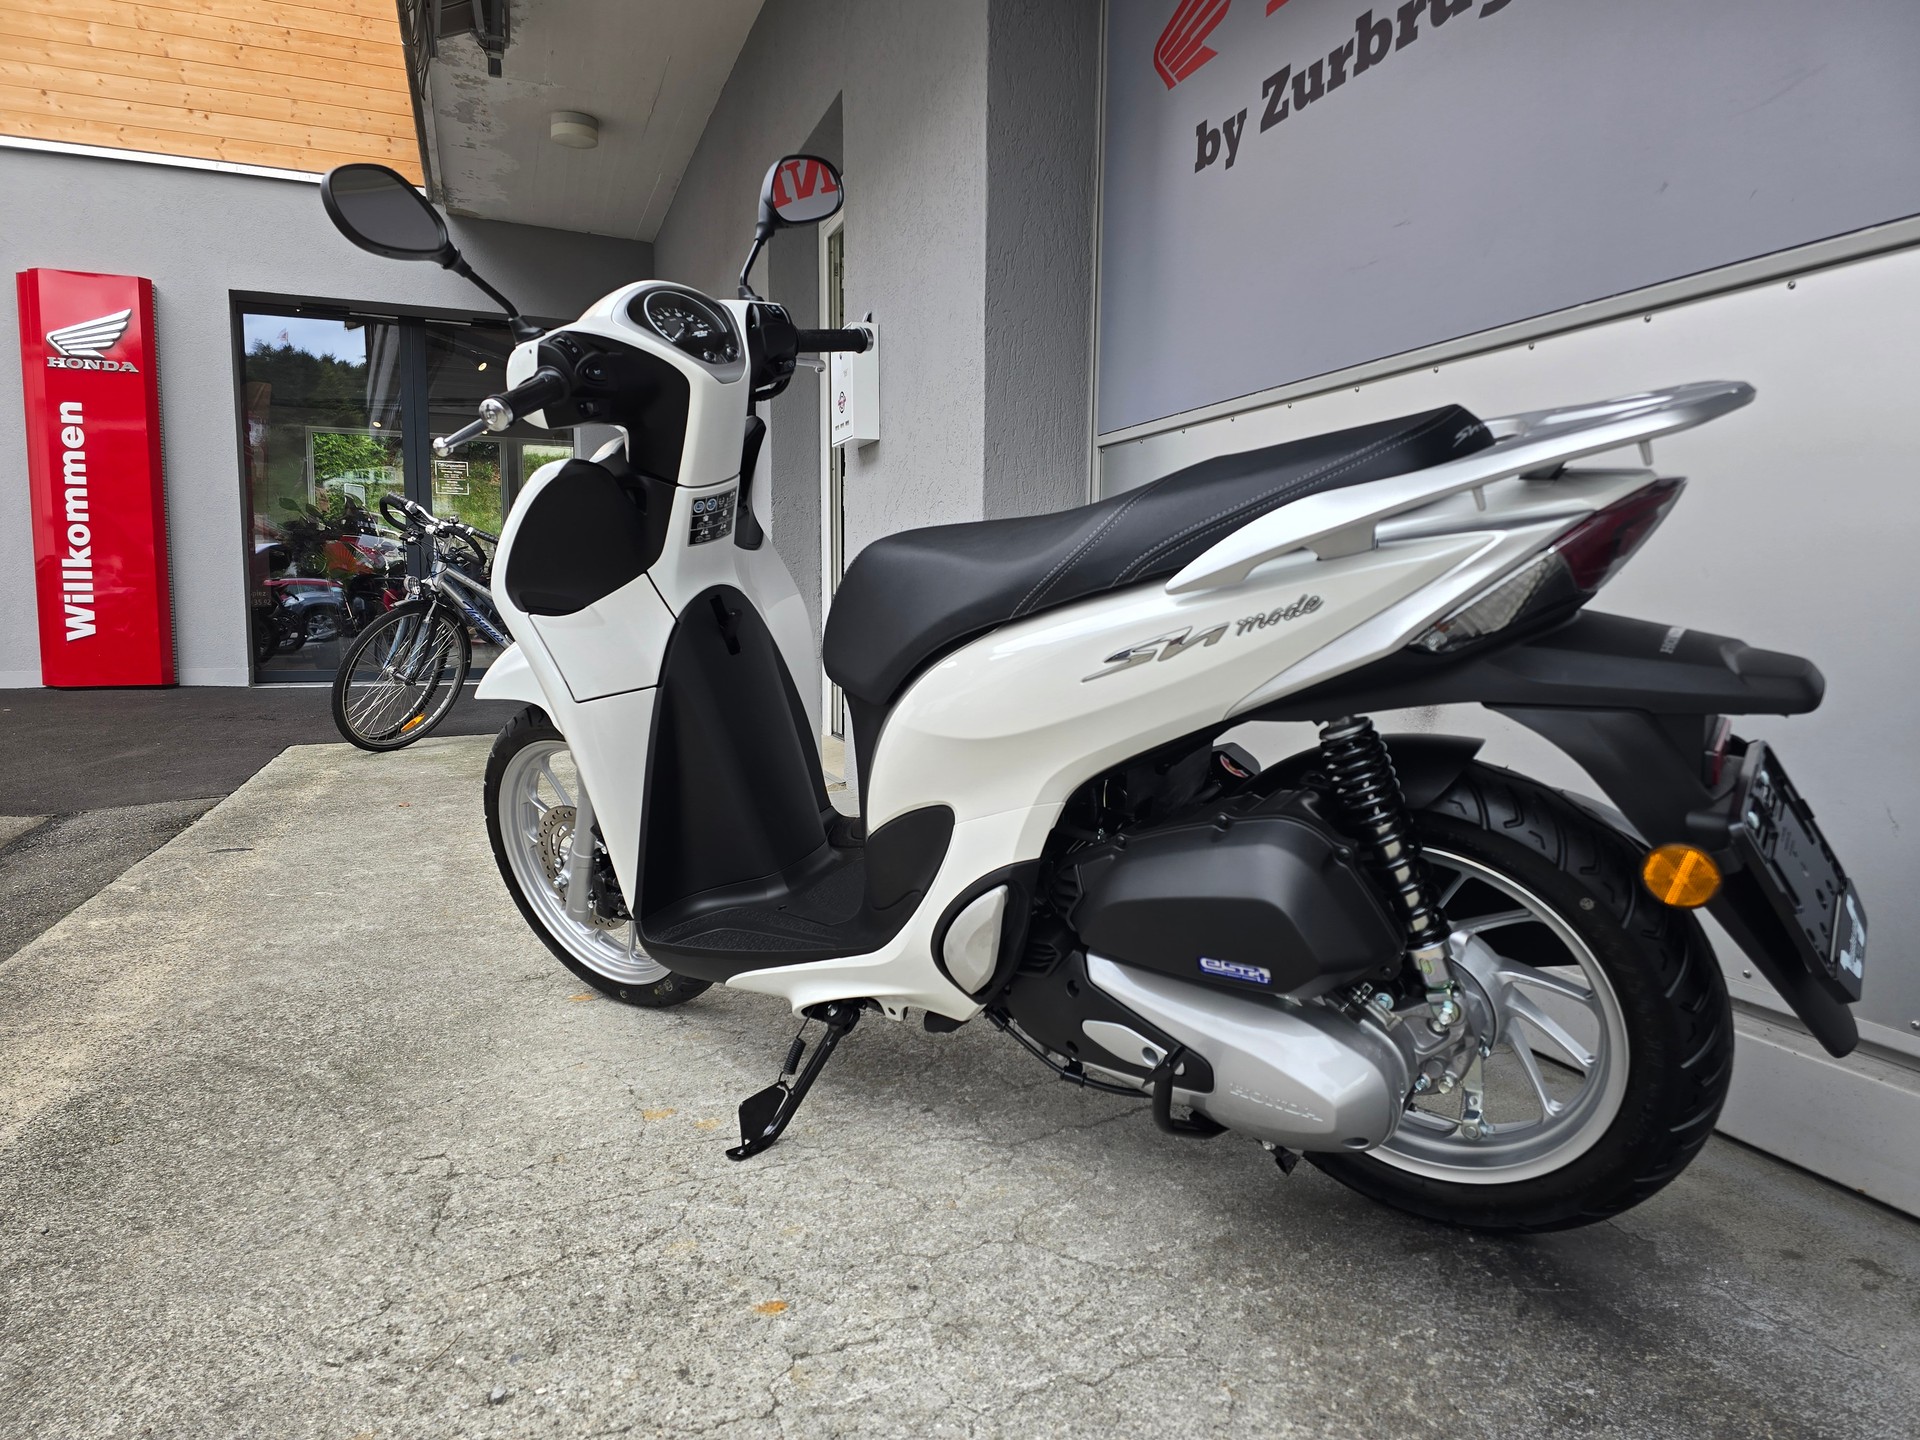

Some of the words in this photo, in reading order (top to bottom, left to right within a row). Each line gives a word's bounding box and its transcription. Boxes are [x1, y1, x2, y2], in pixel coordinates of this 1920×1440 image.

[1195, 107, 1248, 173] by
[47, 356, 139, 373] HONDA
[59, 401, 97, 642] Willkommen
[1236, 593, 1325, 637] mode
